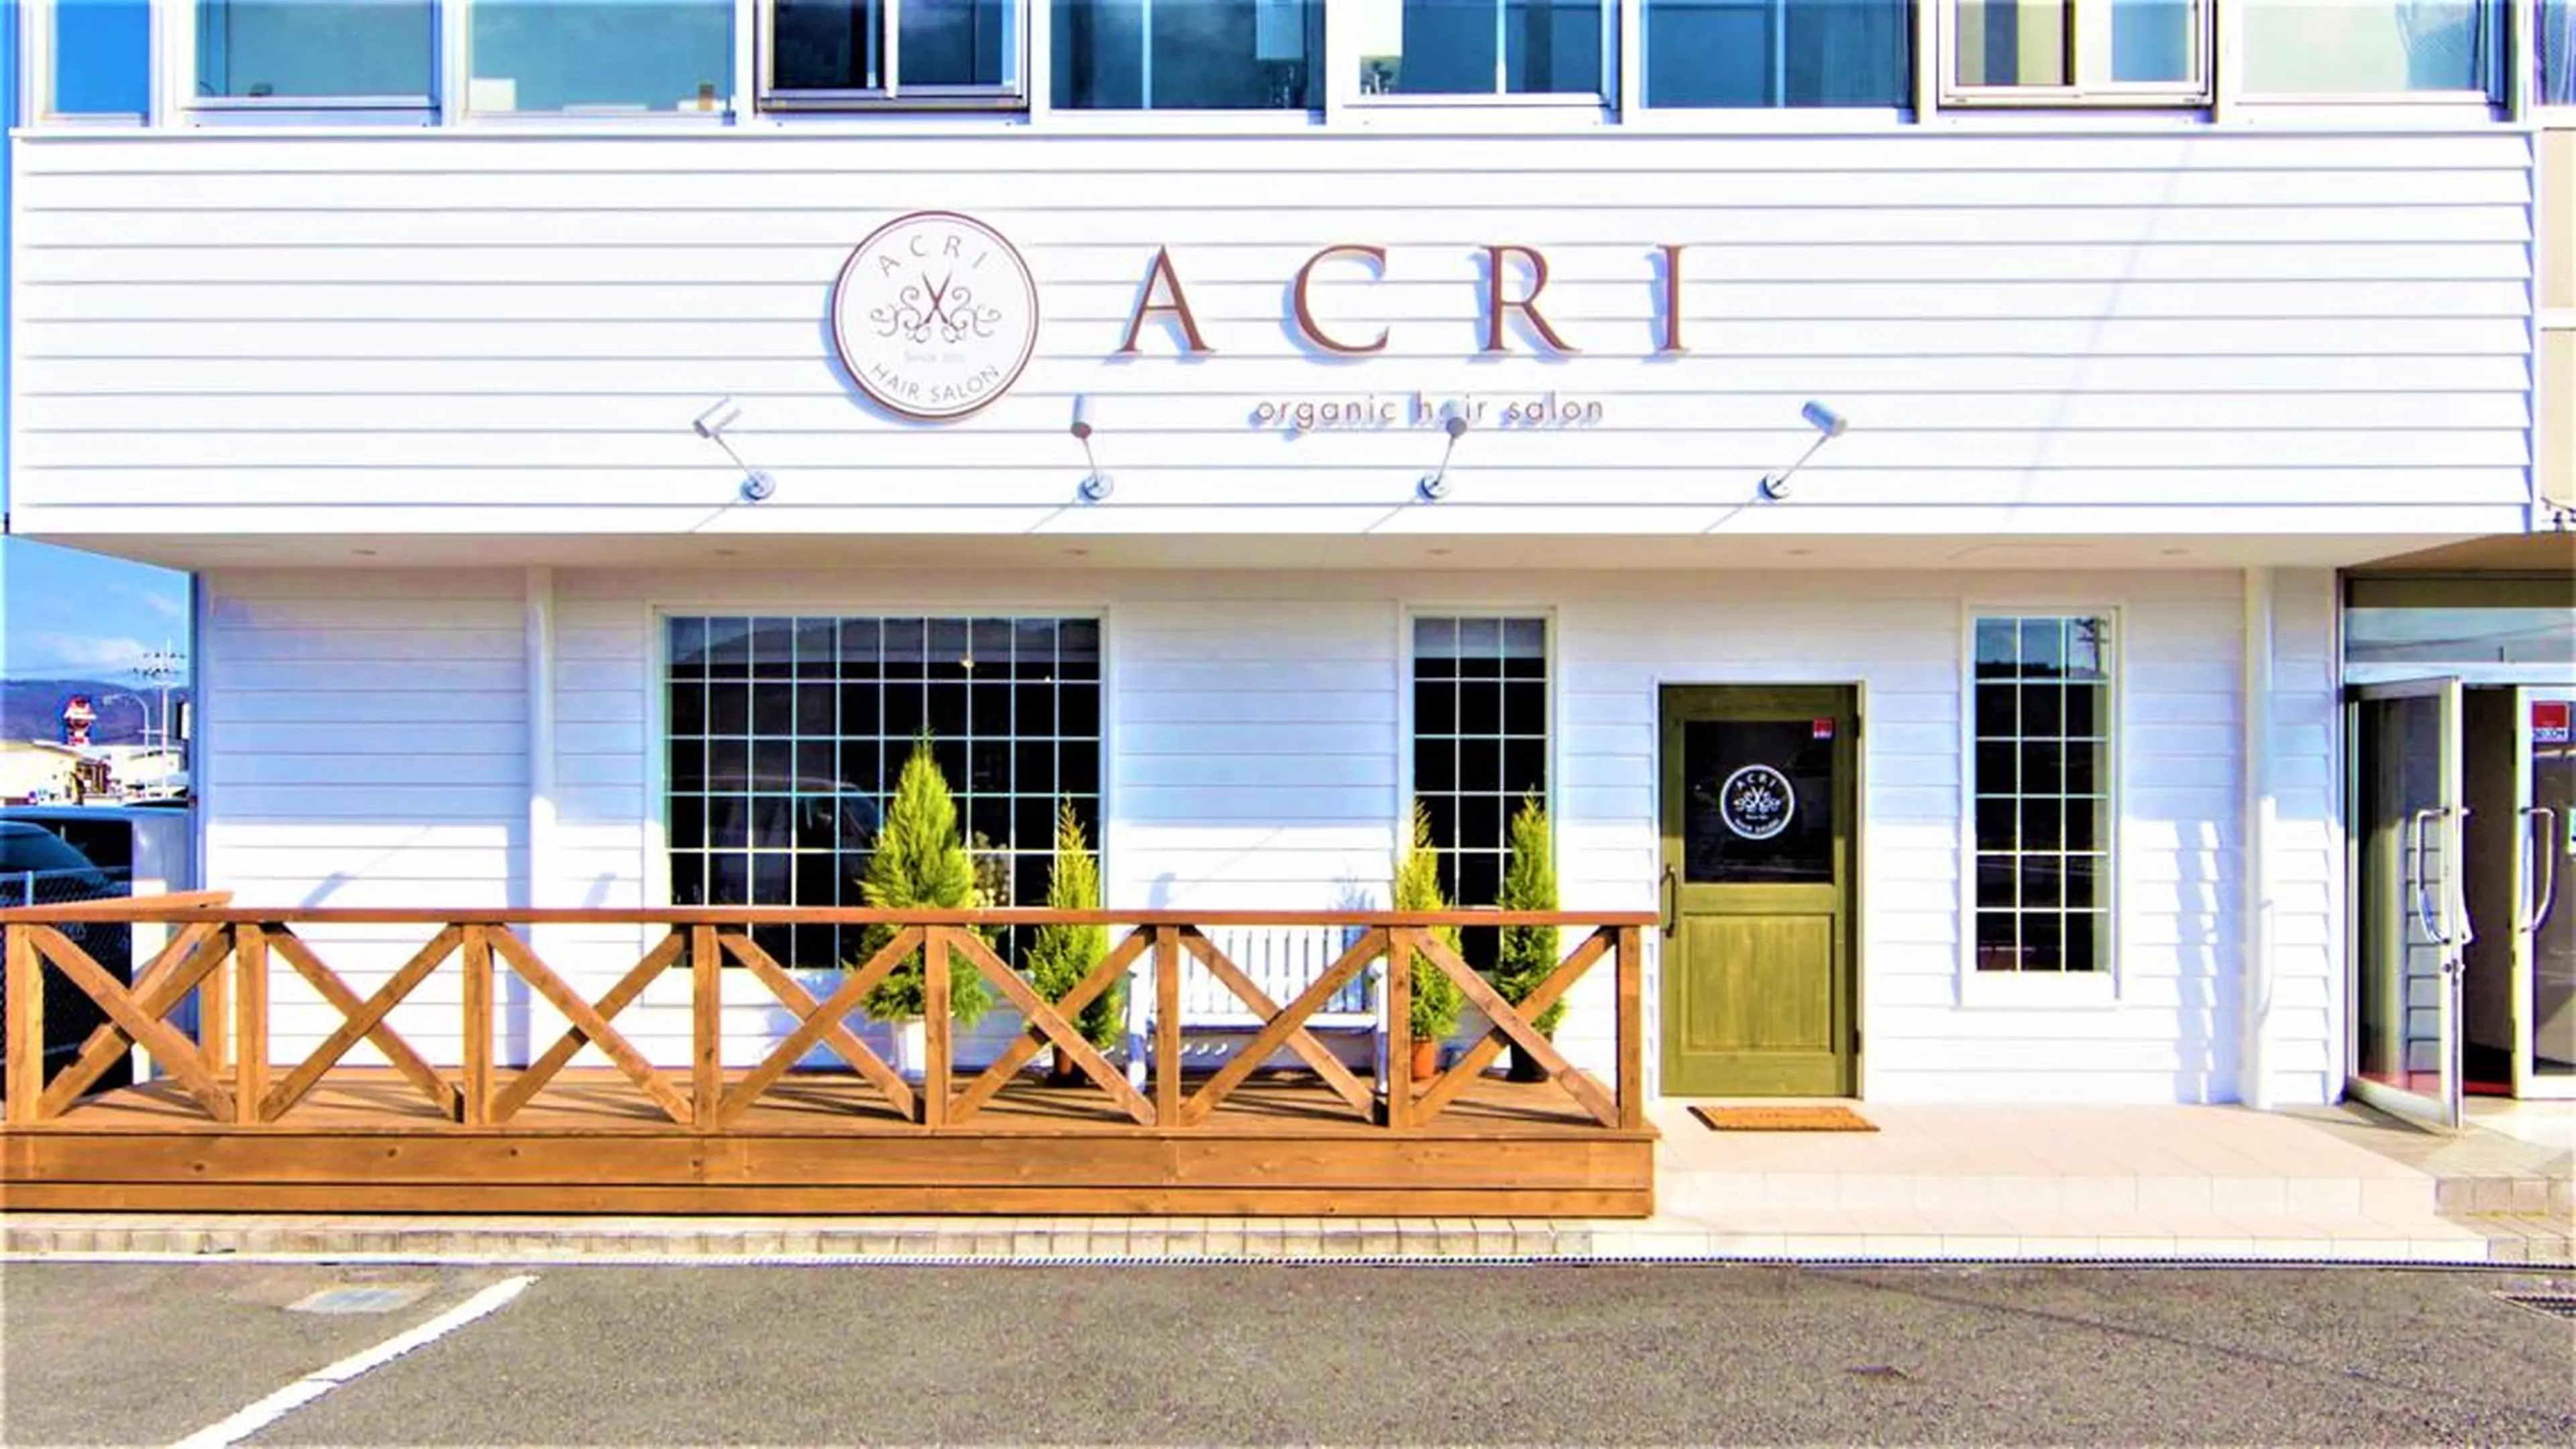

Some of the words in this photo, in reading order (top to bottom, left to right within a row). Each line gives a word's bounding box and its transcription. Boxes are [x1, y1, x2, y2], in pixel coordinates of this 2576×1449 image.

[877, 235, 987, 278] ACRI
[1116, 244, 1688, 353] ACRI
[870, 363, 920, 400] HAIR
[930, 363, 1000, 402] SALON
[1256, 394, 1397, 428] organic
[1508, 390, 1603, 420] salon
[1736, 773, 1776, 790] ACRI
